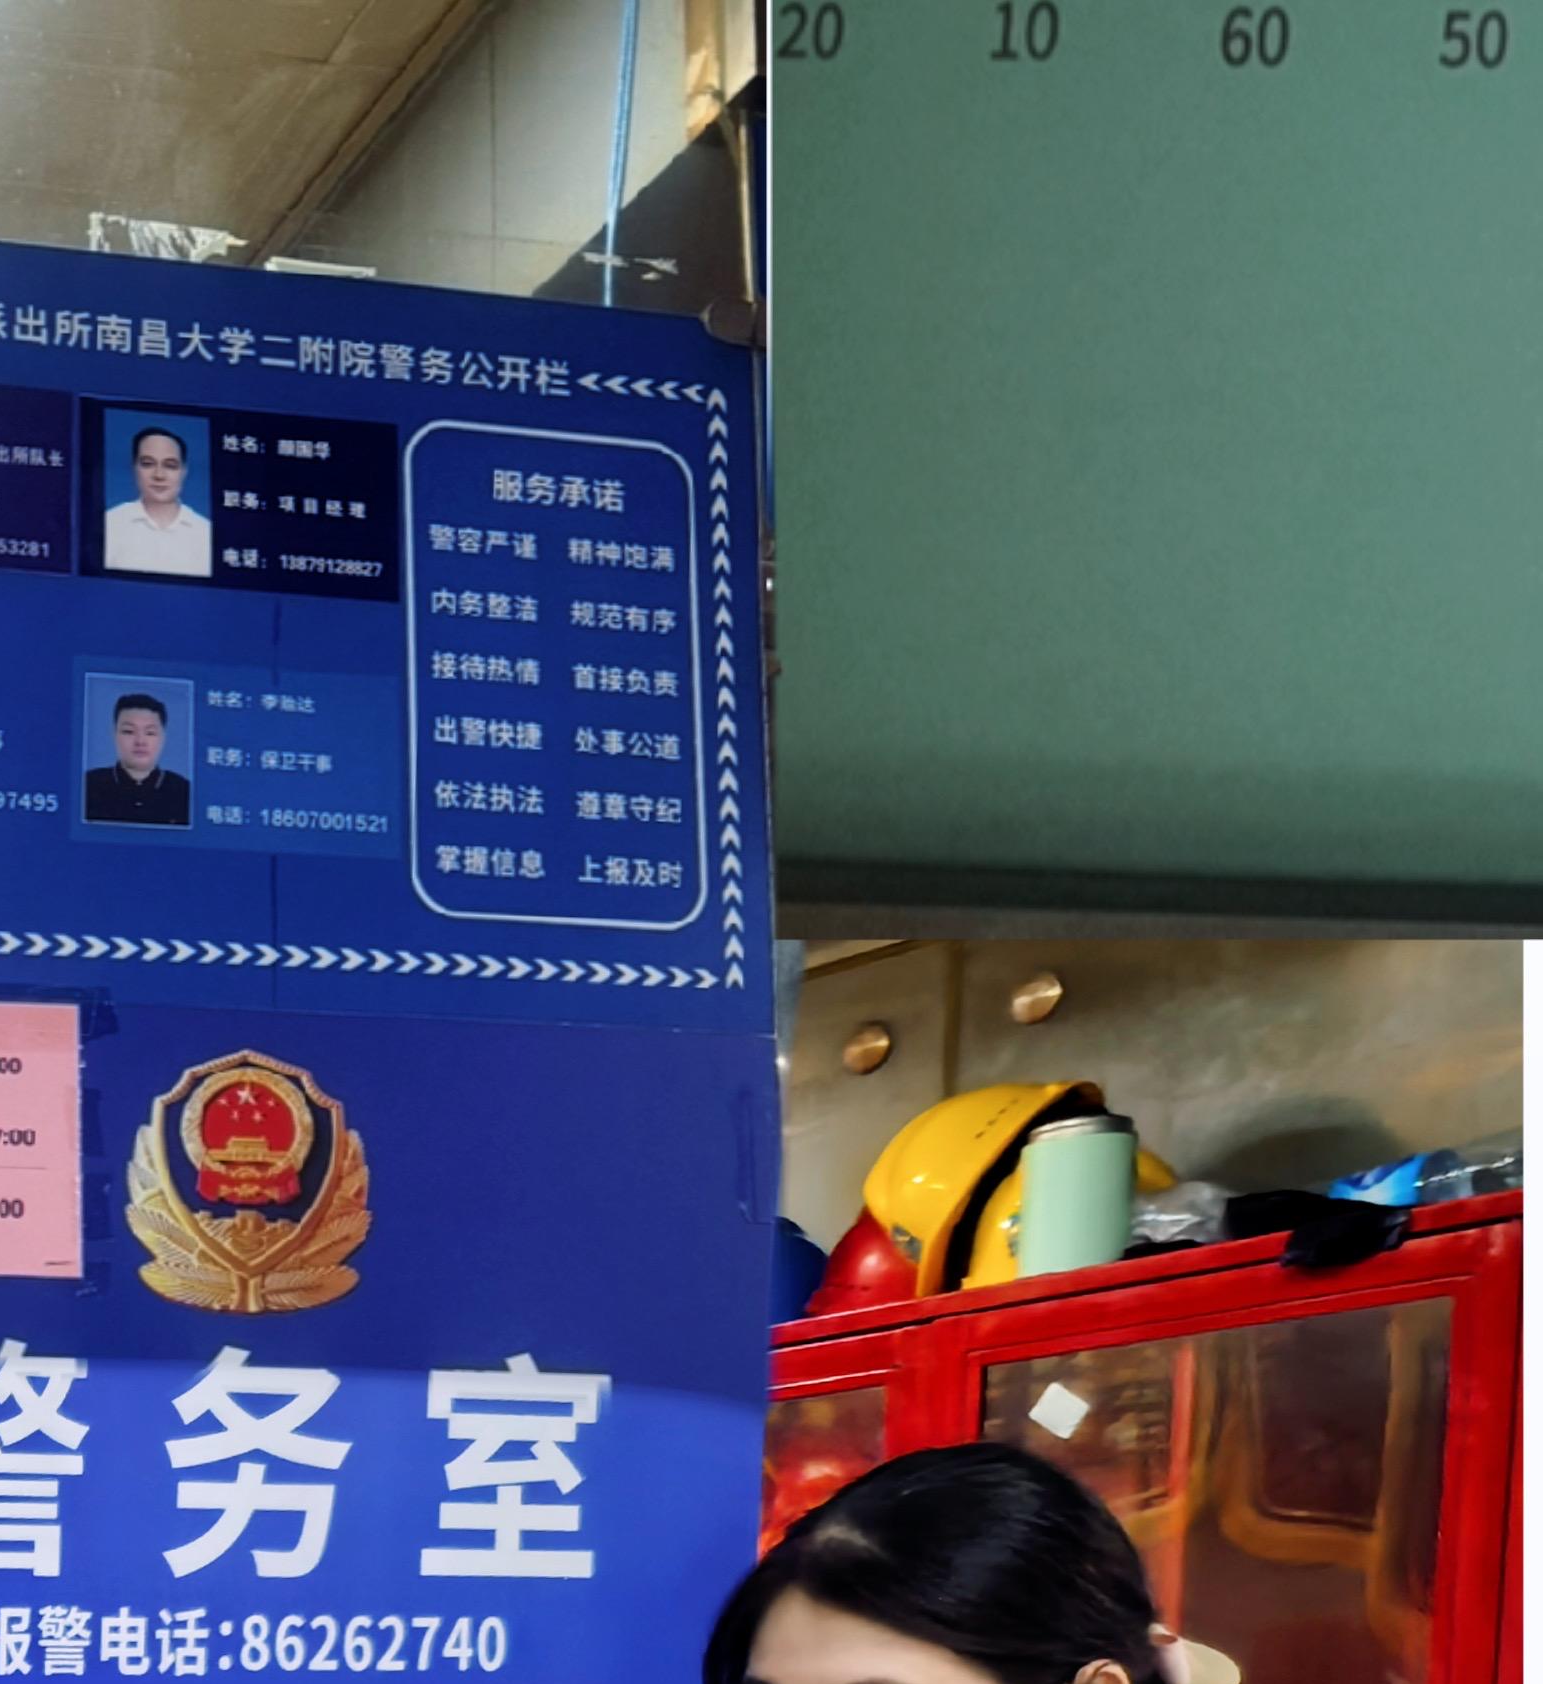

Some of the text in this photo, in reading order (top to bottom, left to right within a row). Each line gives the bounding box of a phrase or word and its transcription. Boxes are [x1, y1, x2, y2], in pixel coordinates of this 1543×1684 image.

[776, 1, 845, 60] 20
[988, 1, 1060, 61] 10
[1220, 5, 1290, 67] 60
[1439, 10, 1508, 70] 50
[493, 468, 625, 513] 服务承诺
[429, 523, 675, 572] 警容严谨 精神饱满
[431, 587, 677, 635] 内务整洁 规范有序
[431, 650, 678, 697] 接待热情 首接负责
[433, 714, 681, 761] 出警快捷 处事公道
[435, 779, 682, 824] 依法执法 遵章守纪
[435, 843, 683, 888] 掌握信息 上报及时
